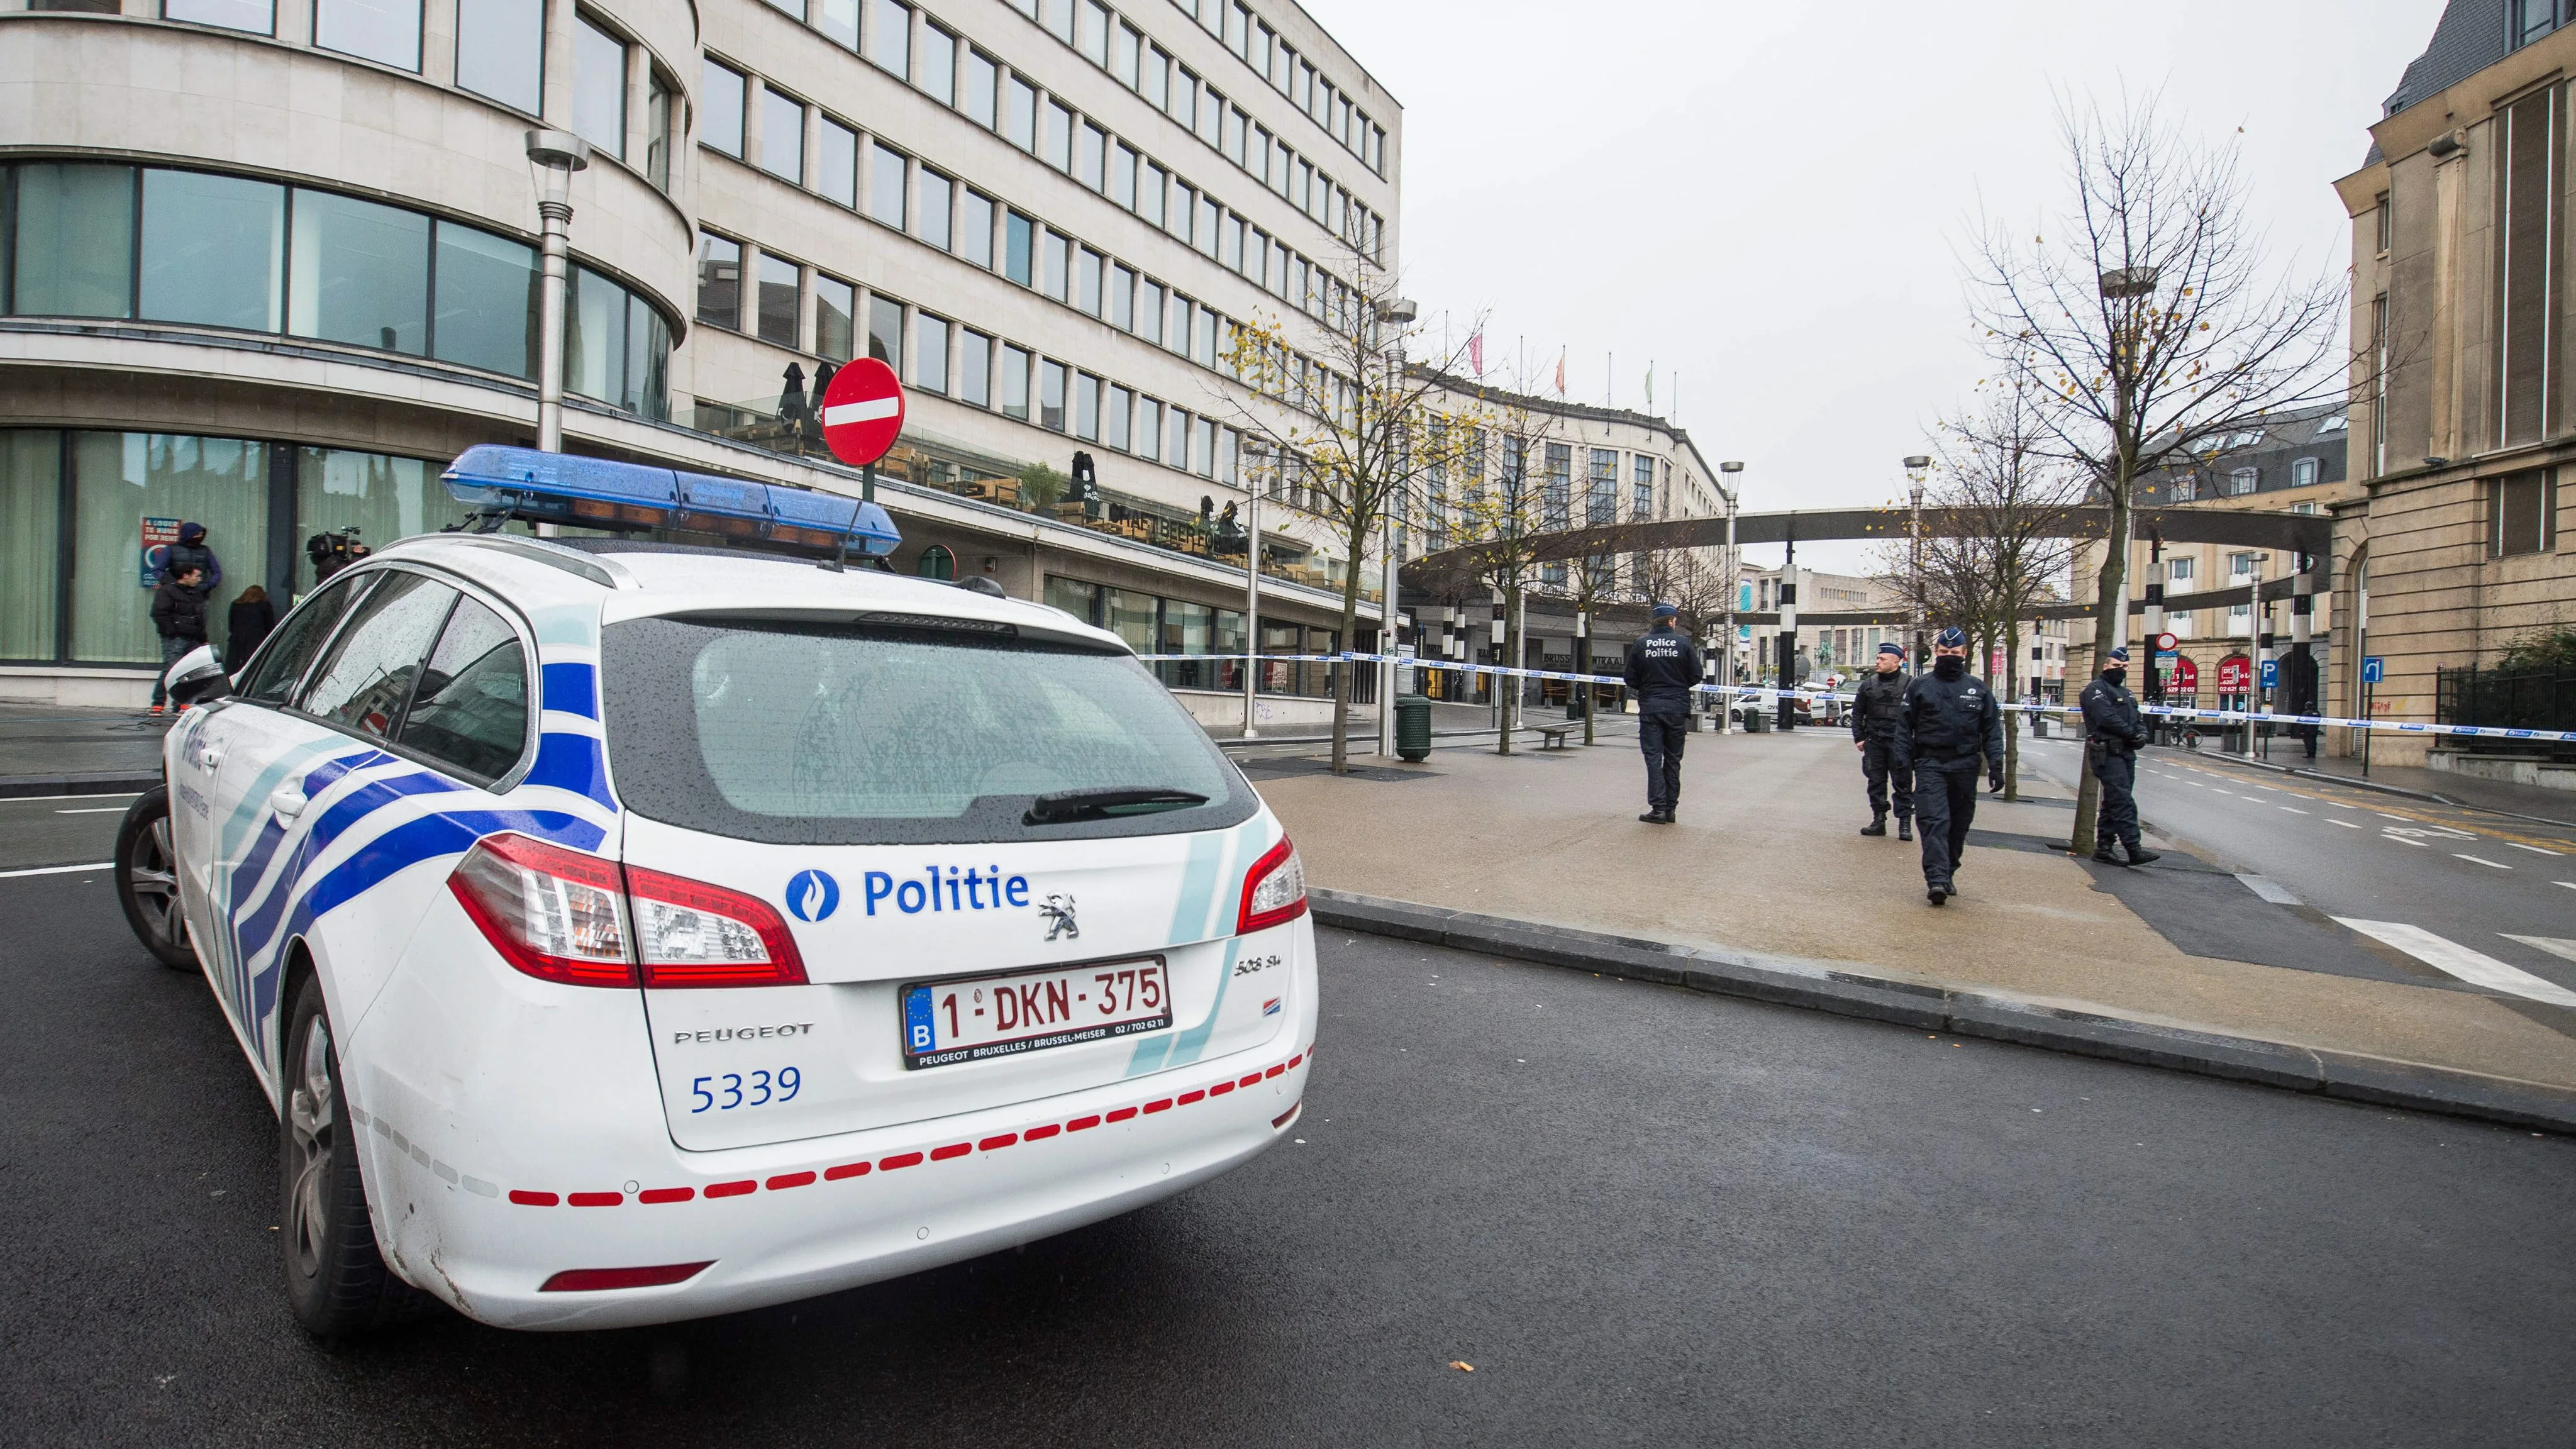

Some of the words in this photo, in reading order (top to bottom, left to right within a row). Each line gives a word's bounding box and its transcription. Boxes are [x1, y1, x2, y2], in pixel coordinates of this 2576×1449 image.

[1645, 648, 1679, 658] Politie
[1646, 638, 1677, 647] Police
[2263, 663, 2276, 677] P
[865, 865, 1030, 916] Politie
[674, 1021, 816, 1045] PEUGEOT
[913, 1025, 931, 1048] B
[919, 1050, 969, 1066] PEUGEOT
[973, 1041, 1026, 1058] BRUXELLES
[1033, 1029, 1106, 1048] BRUSSEL-MEISER
[1115, 1026, 1126, 1034] 02
[1131, 1022, 1146, 1031] 702
[1146, 1020, 1157, 1028] 62
[1158, 1018, 1164, 1026] 11
[692, 1067, 801, 1113] 5339
